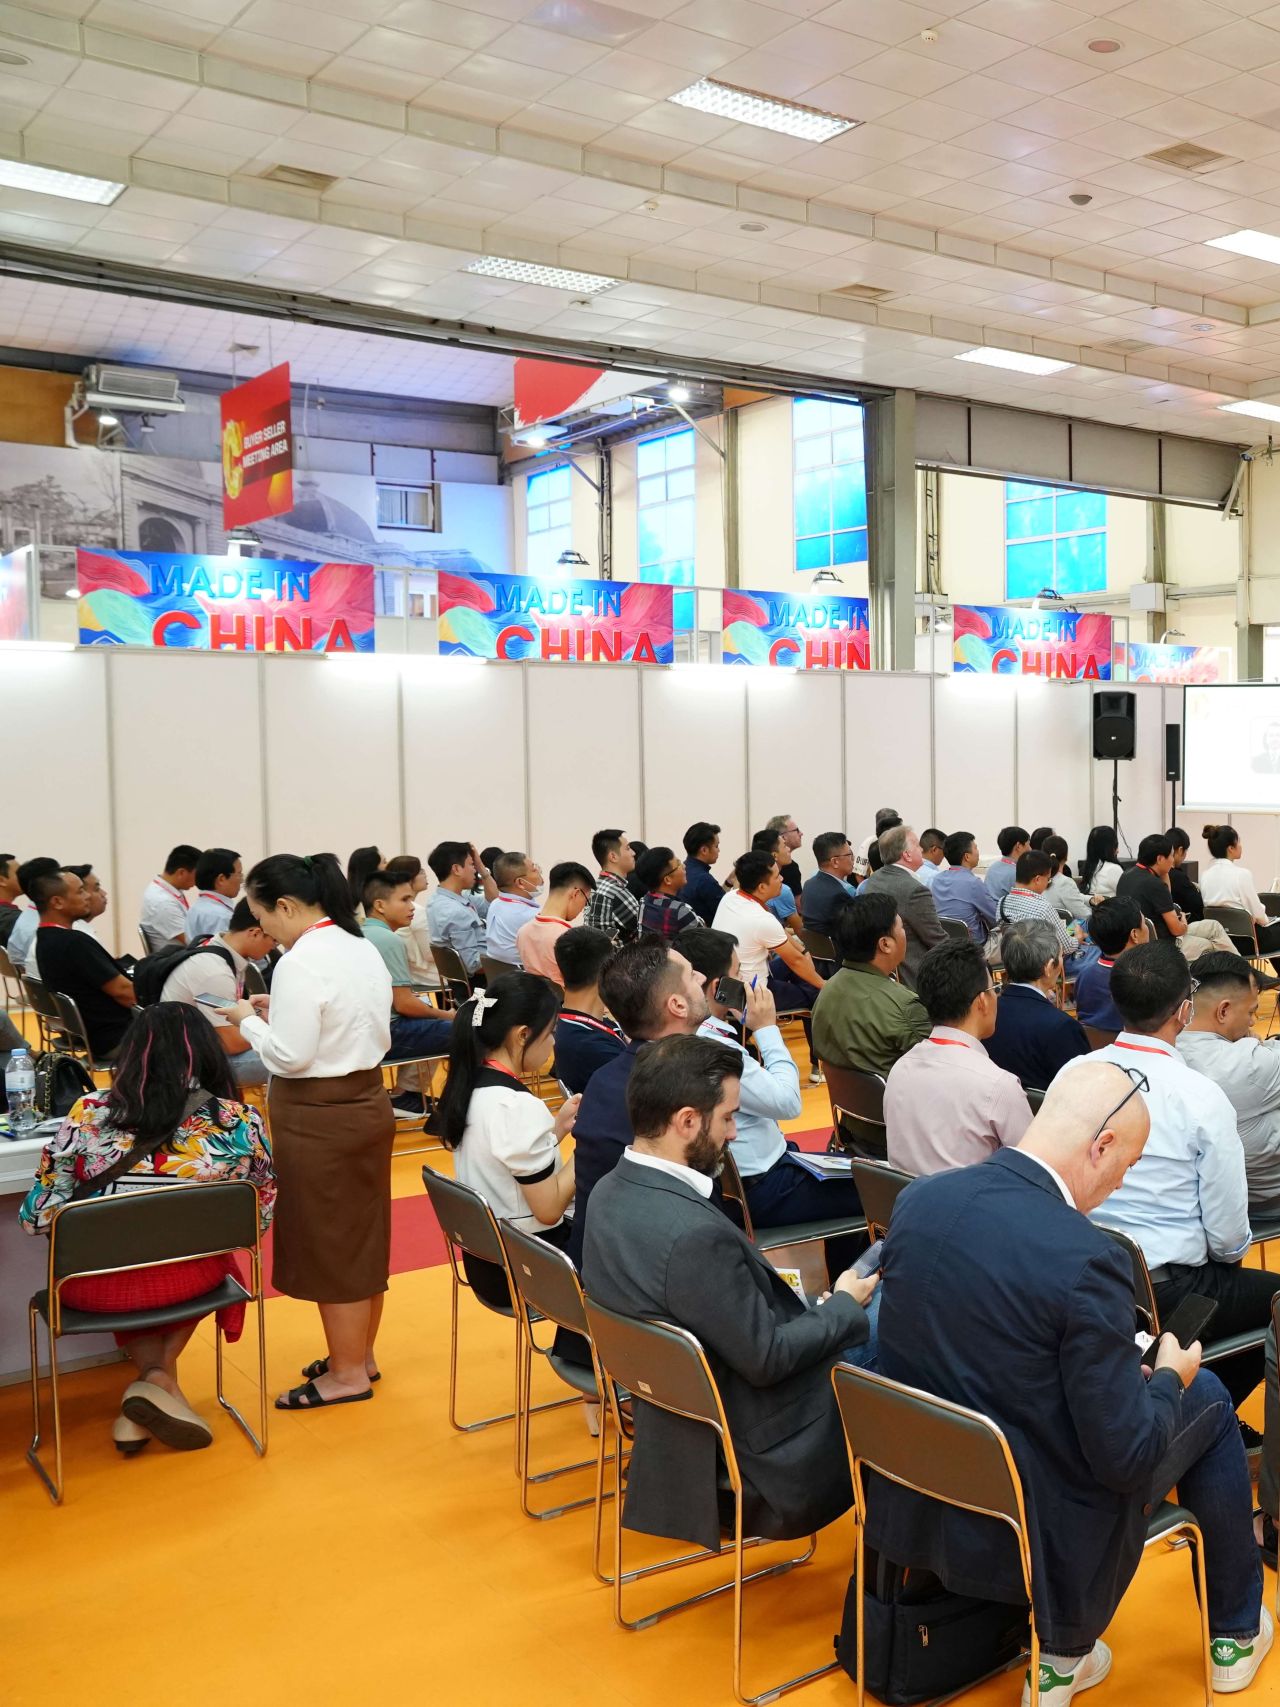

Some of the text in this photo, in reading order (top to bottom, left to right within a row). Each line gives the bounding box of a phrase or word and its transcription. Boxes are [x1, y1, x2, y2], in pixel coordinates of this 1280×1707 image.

[243, 420, 286, 449] BUYER SELLER
[242, 438, 289, 468] MEETING AREA
[149, 564, 311, 602] MADE IN
[494, 584, 621, 617] MADE IN
[767, 601, 869, 631] MADE IN
[152, 611, 356, 652] CHINA
[495, 626, 658, 663] CHINA
[991, 615, 1077, 642] MADE IN
[768, 637, 870, 671] CHIN
[991, 649, 1100, 681] CHINA
